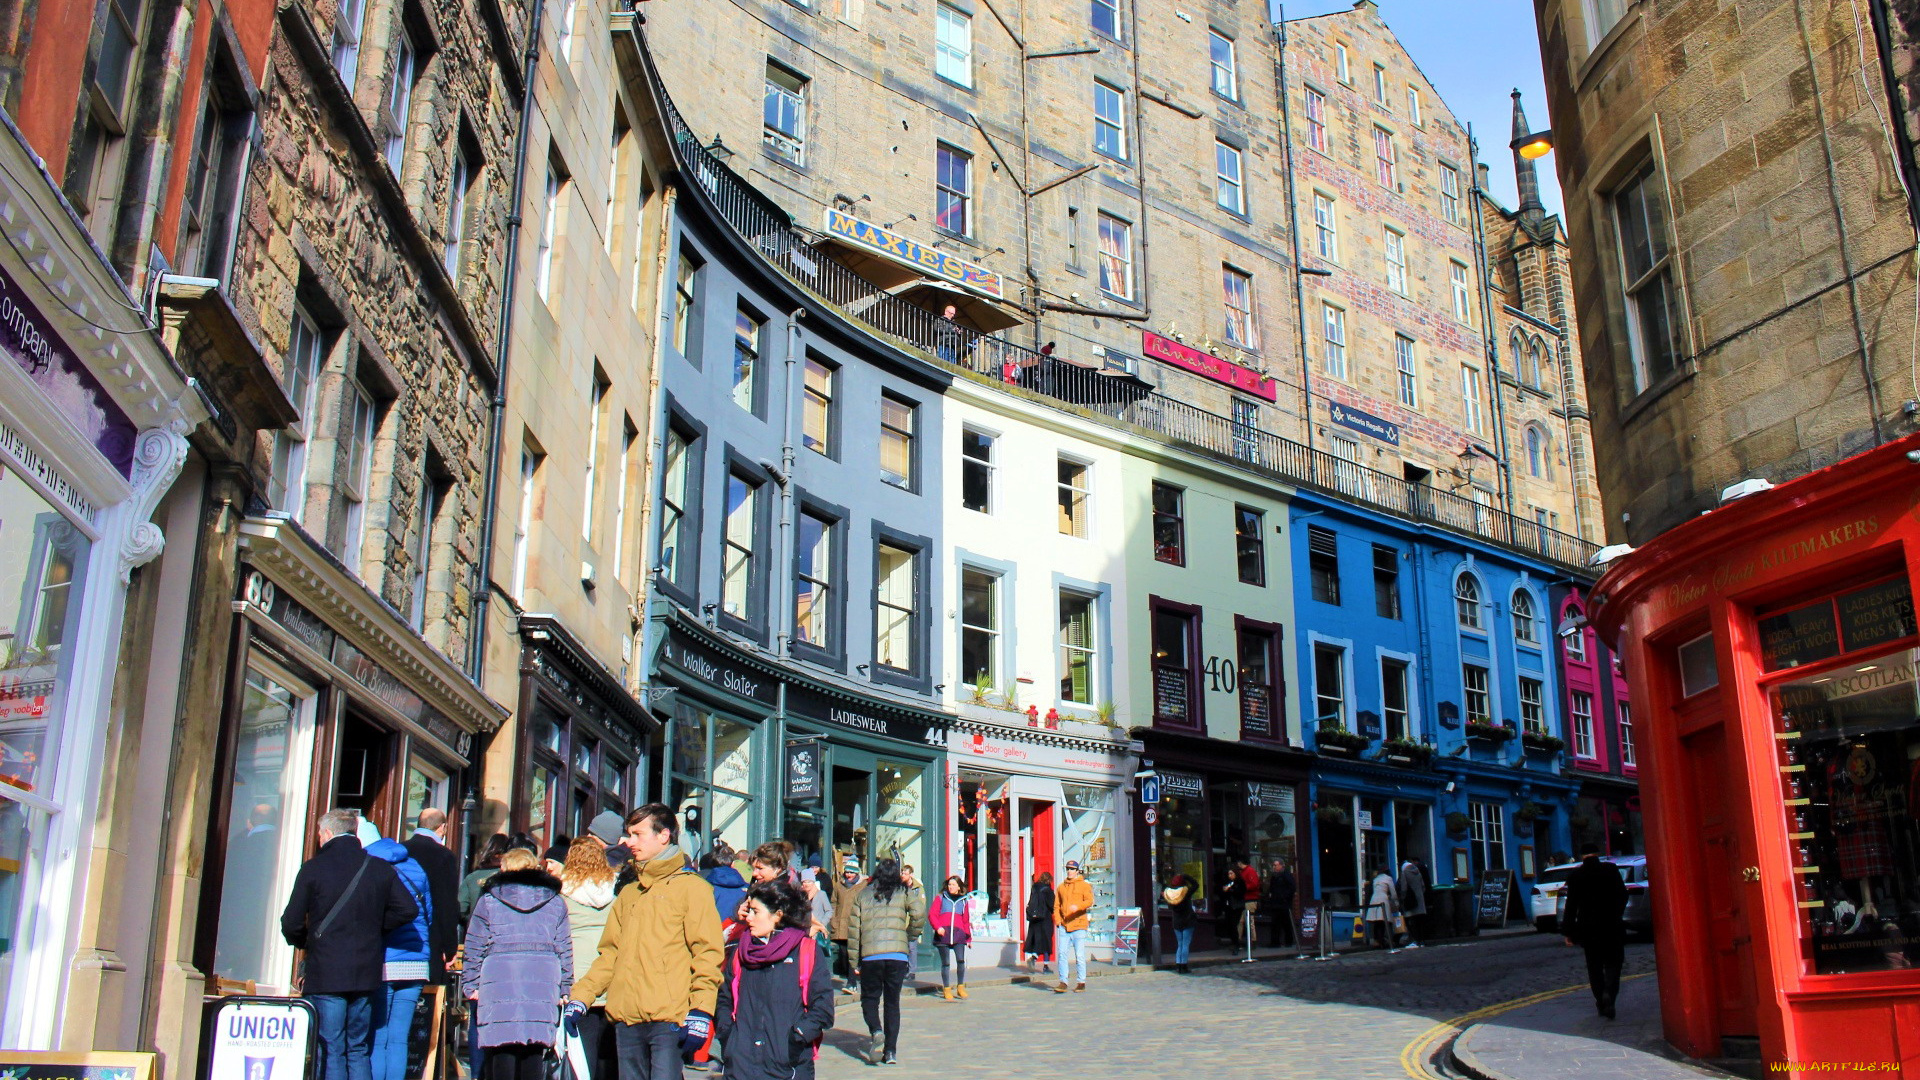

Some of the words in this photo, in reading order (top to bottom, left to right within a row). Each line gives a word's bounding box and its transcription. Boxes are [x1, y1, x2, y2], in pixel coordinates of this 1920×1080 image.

[831, 213, 965, 279] MAXIES
[1346, 413, 1366, 427] Victoria
[1365, 420, 1384, 434] Regalia
[1668, 574, 1707, 608] Victor
[1712, 561, 1756, 595] Scott
[1761, 515, 1879, 569] KILTMAKERS
[247, 570, 275, 614] 89
[1845, 594, 1884, 613] LADIES
[1854, 610, 1880, 627] KIDS
[1881, 600, 1911, 619] KILTS
[1767, 627, 1793, 644] 100%
[1795, 618, 1828, 636] HEAVY
[1852, 625, 1886, 643] MENS
[1764, 638, 1803, 660] WEIGHT
[1804, 630, 1838, 649] WOOL
[355, 656, 367, 686] La
[683, 649, 717, 681] Walker
[723, 669, 758, 698] Slater
[1204, 656, 1235, 694] 40
[1775, 687, 1817, 710] MADE
[1824, 682, 1839, 699] IN
[830, 707, 888, 734] LADIESWEAR
[458, 731, 471, 757] 89
[962, 740, 974, 748] the
[984, 743, 1001, 753] door
[1003, 747, 1027, 760] gallery
[1064, 758, 1116, 770] www.edinburghart.com
[791, 776, 813, 785] Walker
[791, 784, 813, 793] Slater
[1146, 812, 1156, 821] 20
[1743, 866, 1760, 882] 92
[1821, 943, 1838, 952] REAL
[1838, 940, 1872, 950] SCOTTISH
[1872, 938, 1891, 947] KILTS
[1894, 937, 1909, 945] AND
[229, 1016, 296, 1040] UNION
[272, 1041, 293, 1049] COFFEE
